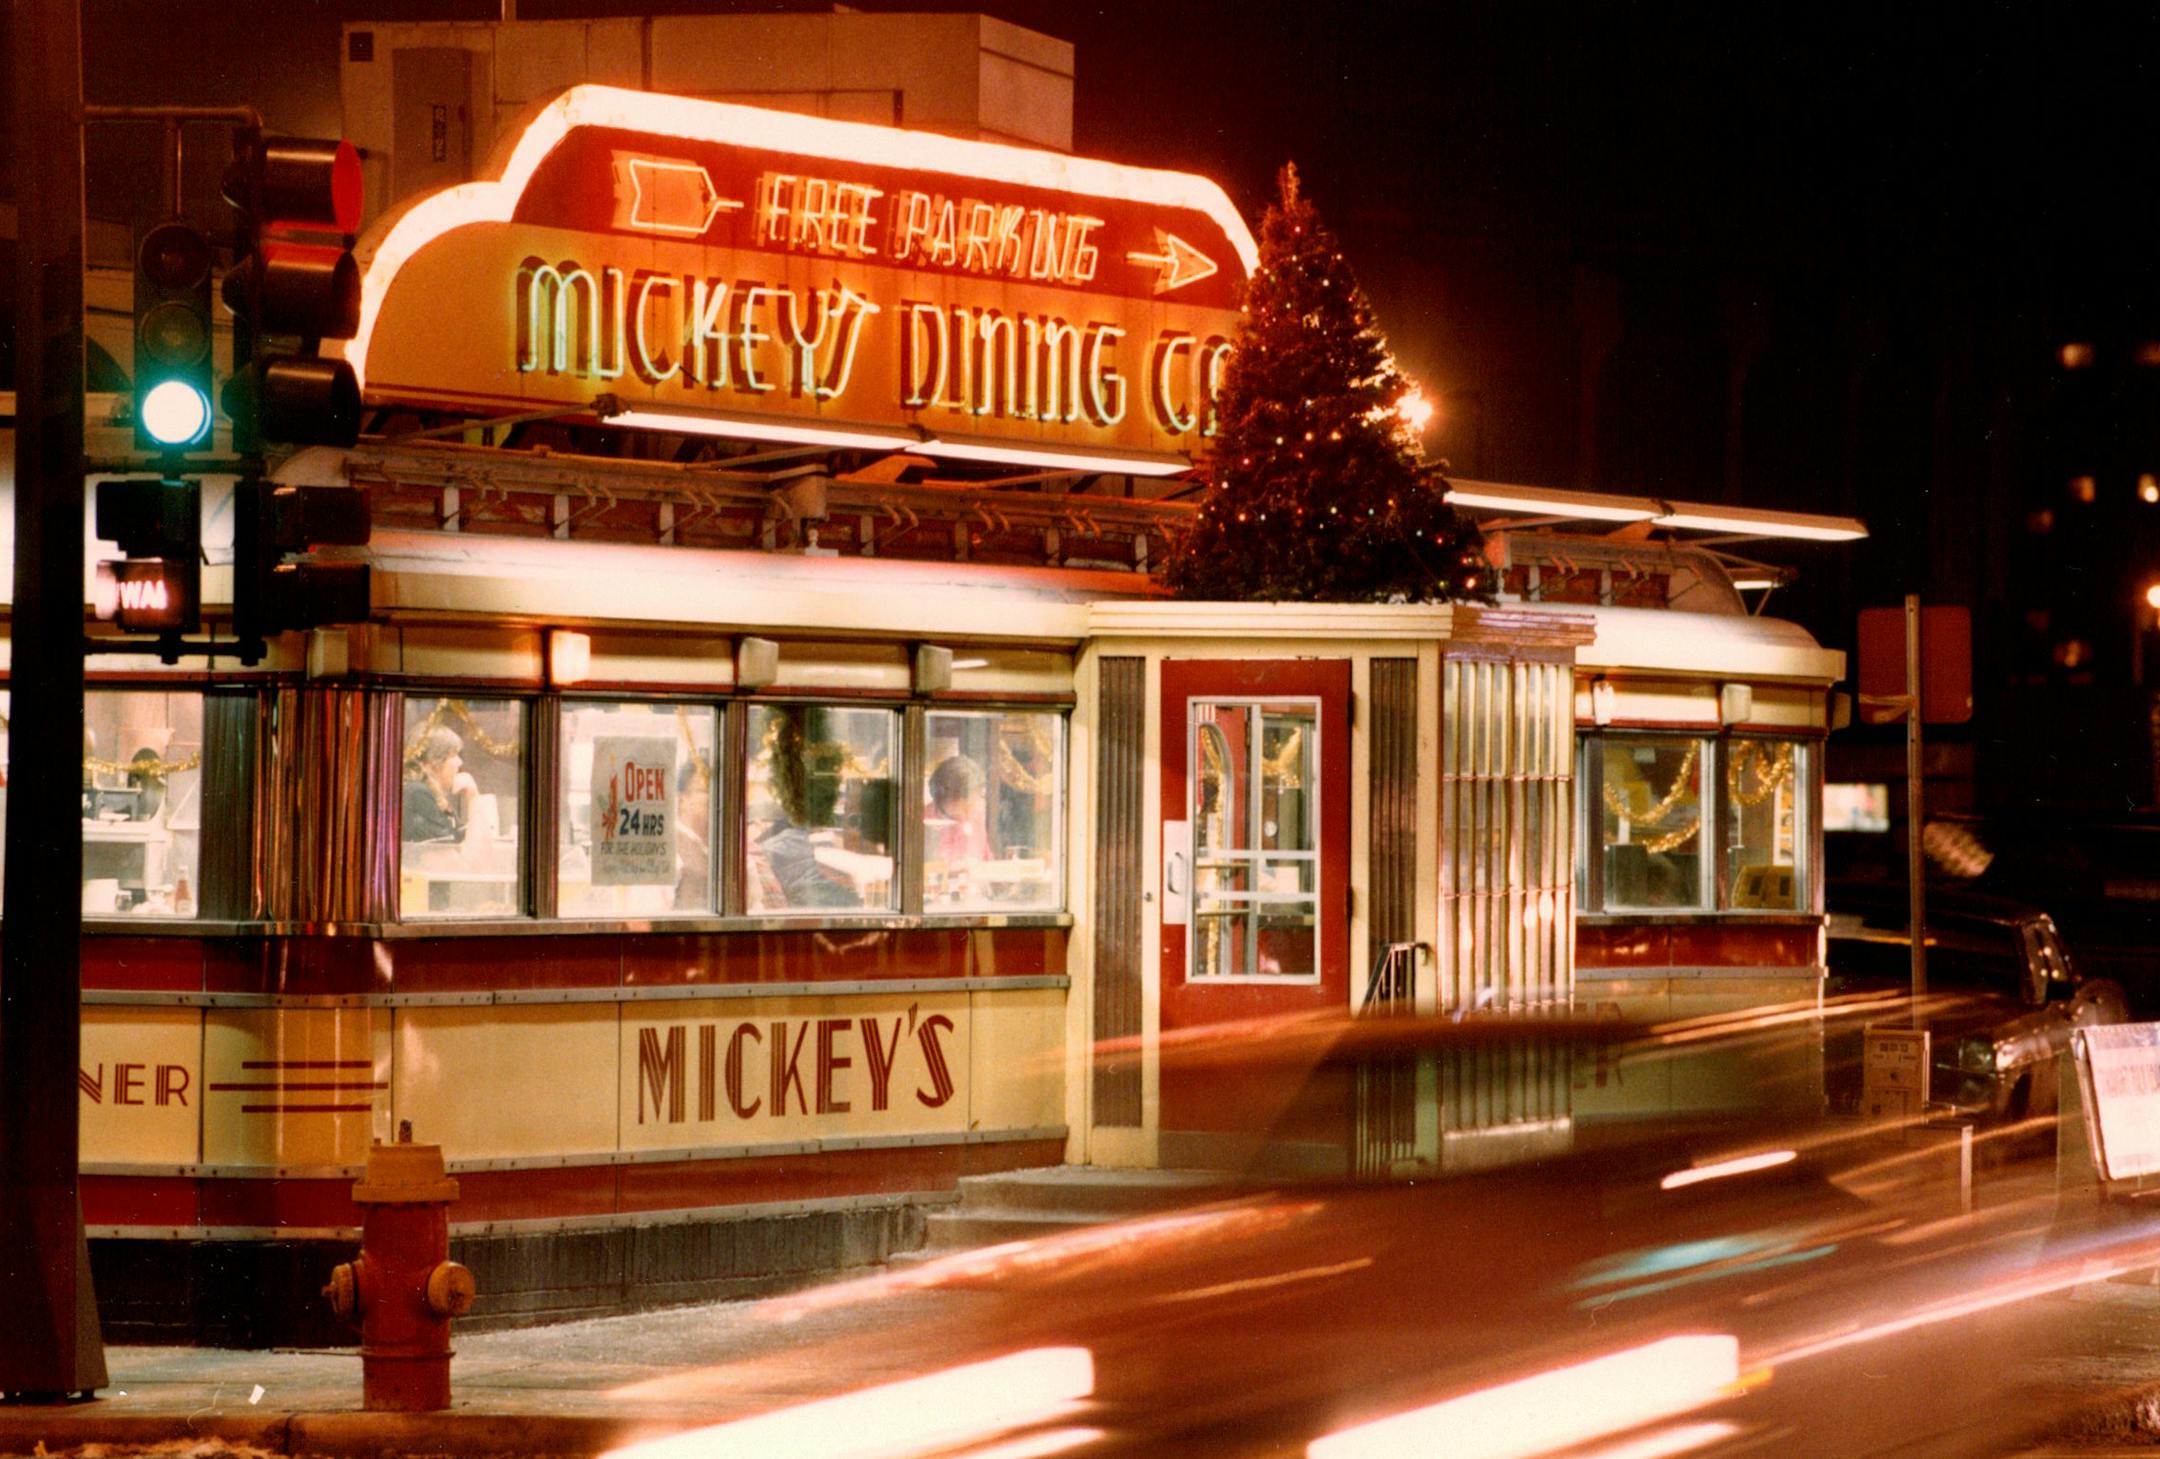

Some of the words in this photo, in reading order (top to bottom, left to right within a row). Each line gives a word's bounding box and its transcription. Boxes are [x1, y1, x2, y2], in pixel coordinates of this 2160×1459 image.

[756, 171, 884, 258] FREE
[890, 190, 1105, 286] PARKING
[516, 255, 881, 402] MICKEY'S
[901, 298, 1127, 428] DINING
[619, 808, 640, 835] 24
[642, 814, 665, 836] HRS
[625, 762, 665, 803] OPEN
[638, 1002, 955, 1125] MICKEY'S
